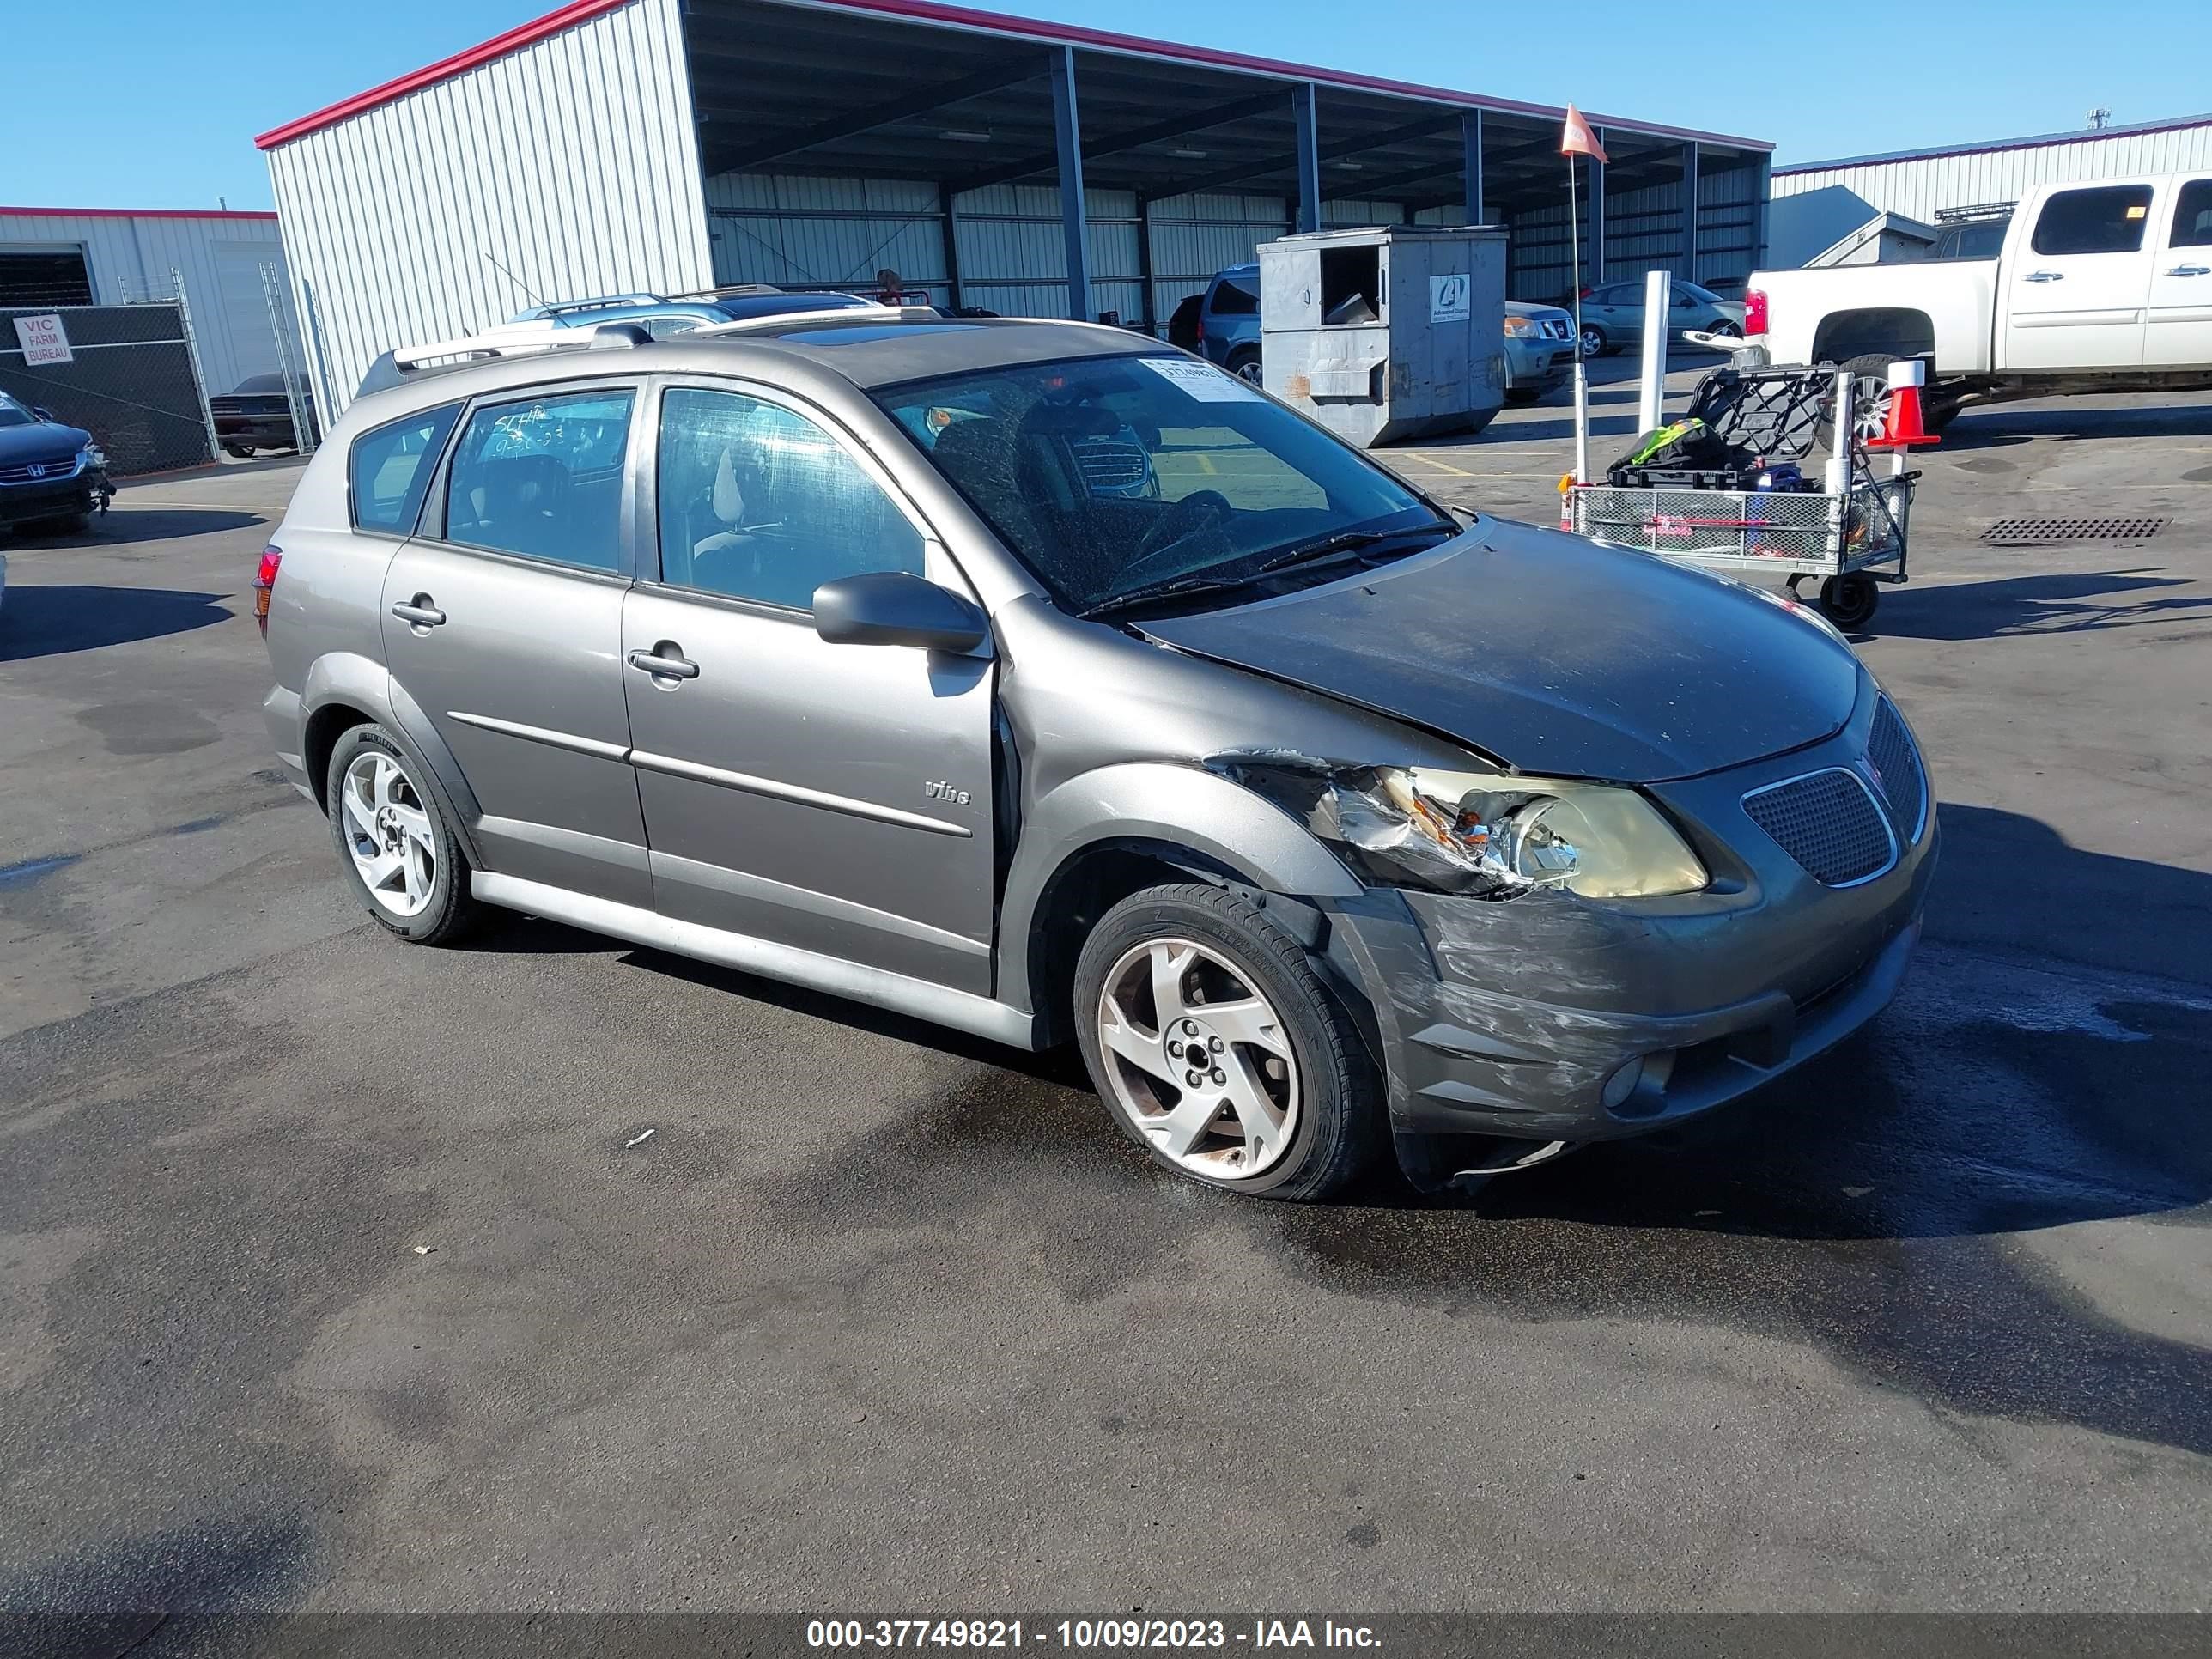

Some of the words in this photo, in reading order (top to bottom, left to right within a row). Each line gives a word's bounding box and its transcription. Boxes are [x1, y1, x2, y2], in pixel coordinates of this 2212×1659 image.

[23, 319, 53, 331] VIC
[28, 333, 58, 346] FARM
[28, 347, 67, 361] BUREAU
[925, 781, 970, 805] vibe
